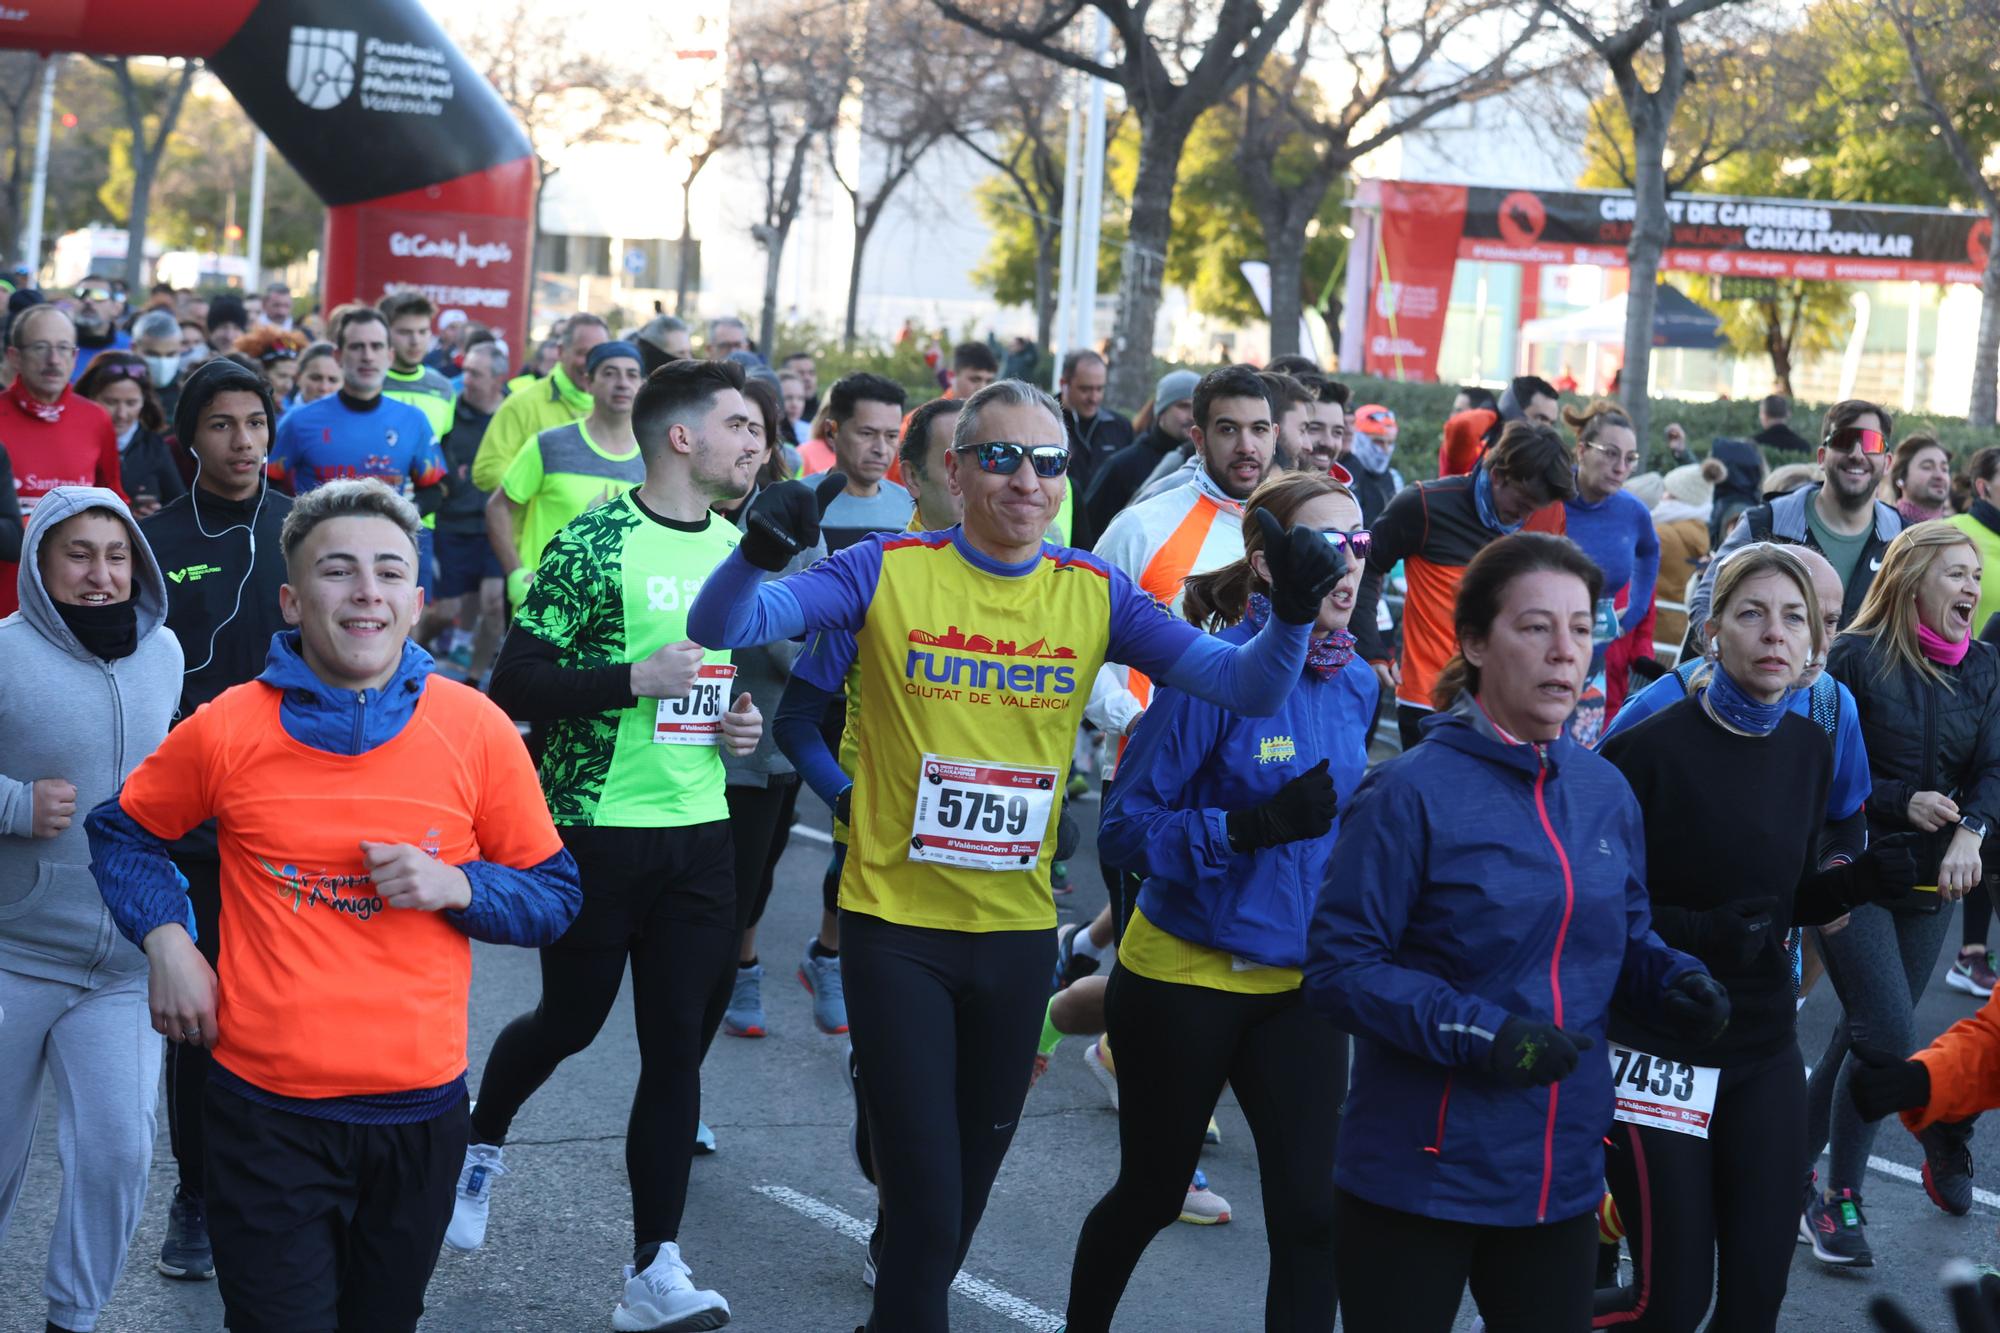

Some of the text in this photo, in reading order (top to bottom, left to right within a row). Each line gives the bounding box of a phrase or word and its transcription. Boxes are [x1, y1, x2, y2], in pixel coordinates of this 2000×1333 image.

[360, 92, 442, 116] València
[361, 76, 453, 101] Municipal
[1600, 198, 1832, 232] CIRT DE CARRERES
[906, 649, 1076, 694] runners
[905, 683, 1070, 710] CIUTAT DE VALÈNCIA
[937, 788, 1029, 835] 5759
[308, 886, 383, 921] Amigo
[1614, 1049, 1695, 1102] 7433
